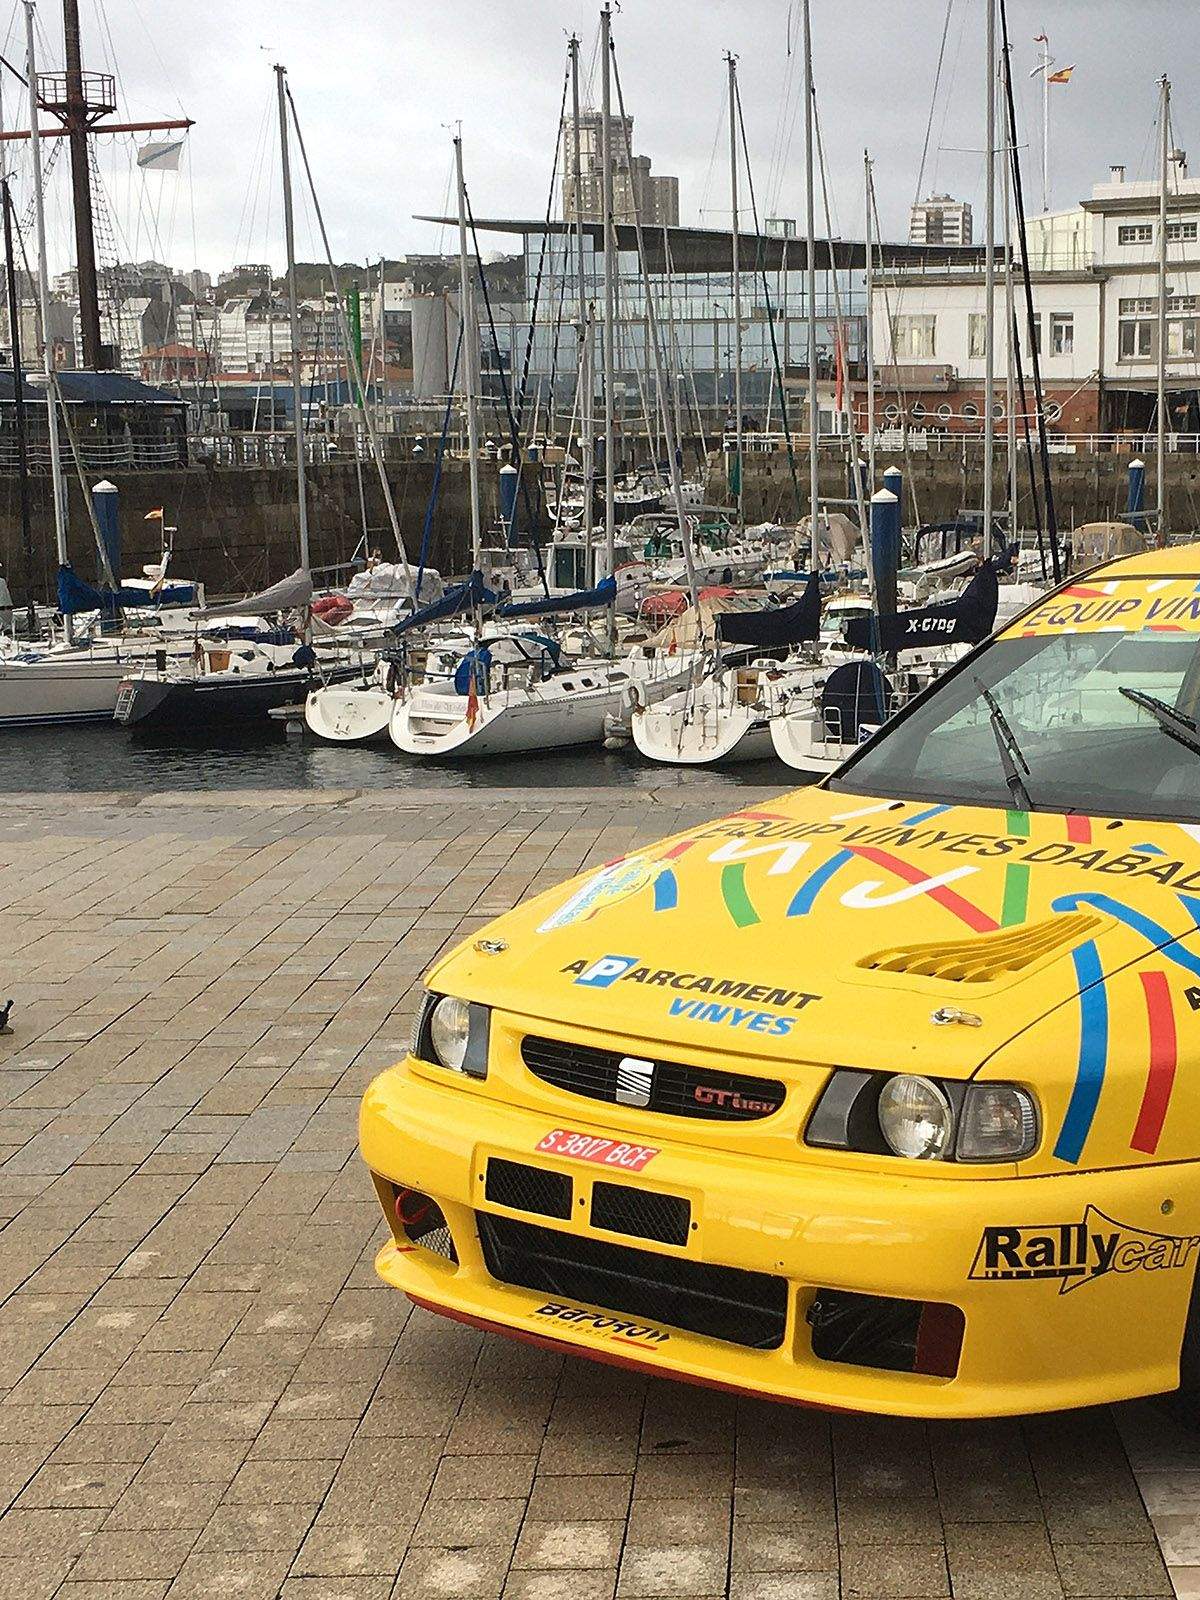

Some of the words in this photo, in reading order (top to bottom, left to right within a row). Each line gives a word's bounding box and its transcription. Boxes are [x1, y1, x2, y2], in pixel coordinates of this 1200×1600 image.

[1025, 598, 1141, 626] EQUIP
[694, 821, 843, 839] EQUIP
[841, 826, 1028, 856] VINYES
[667, 998, 798, 1036] VINYES
[540, 1130, 560, 1149] S
[557, 1133, 611, 1159] 3817
[609, 1143, 659, 1168] BCF
[985, 1225, 1200, 1276] Rallycar
